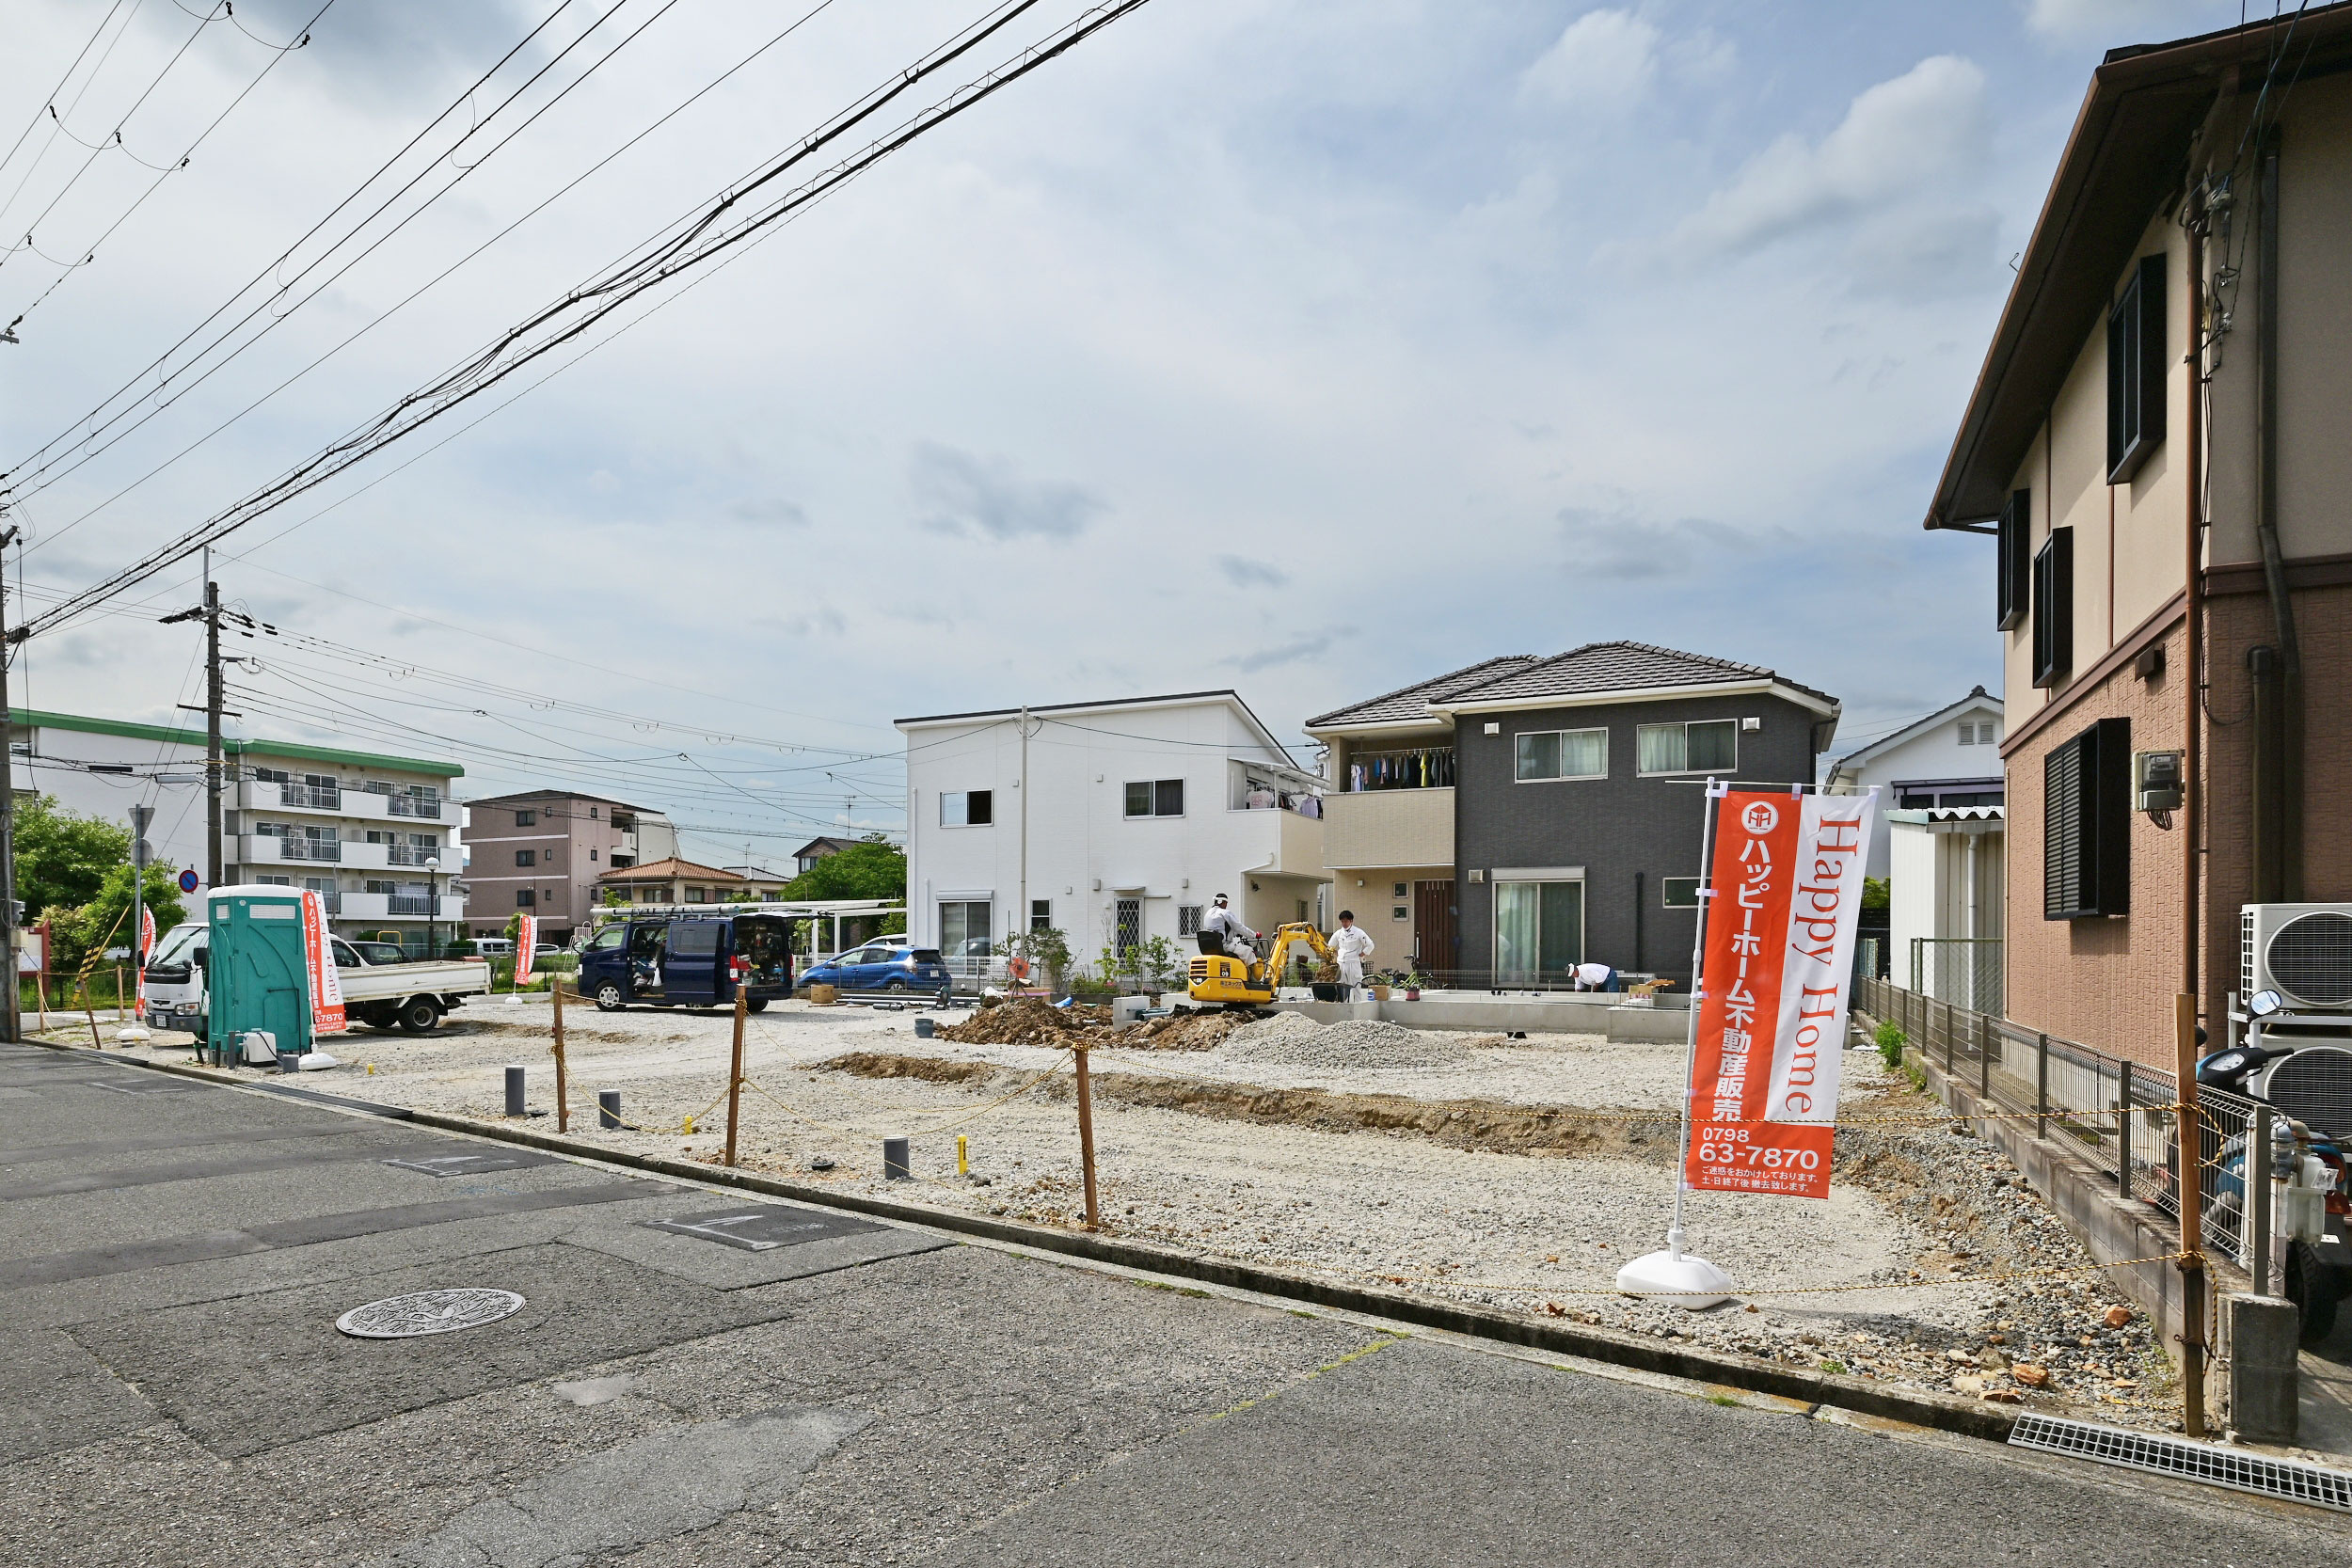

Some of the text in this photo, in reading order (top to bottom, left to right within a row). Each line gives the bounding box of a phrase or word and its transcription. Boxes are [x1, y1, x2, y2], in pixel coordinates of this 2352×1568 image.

[1785, 815, 1862, 1114] Happy Home
[1711, 838, 1772, 1122] ハッピーホーム不動産販売
[1702, 1127, 1750, 1143] 0798
[1699, 1142, 1820, 1170] 63-7870
[1701, 1165, 1819, 1183] ご迷惑をおかけしております。
